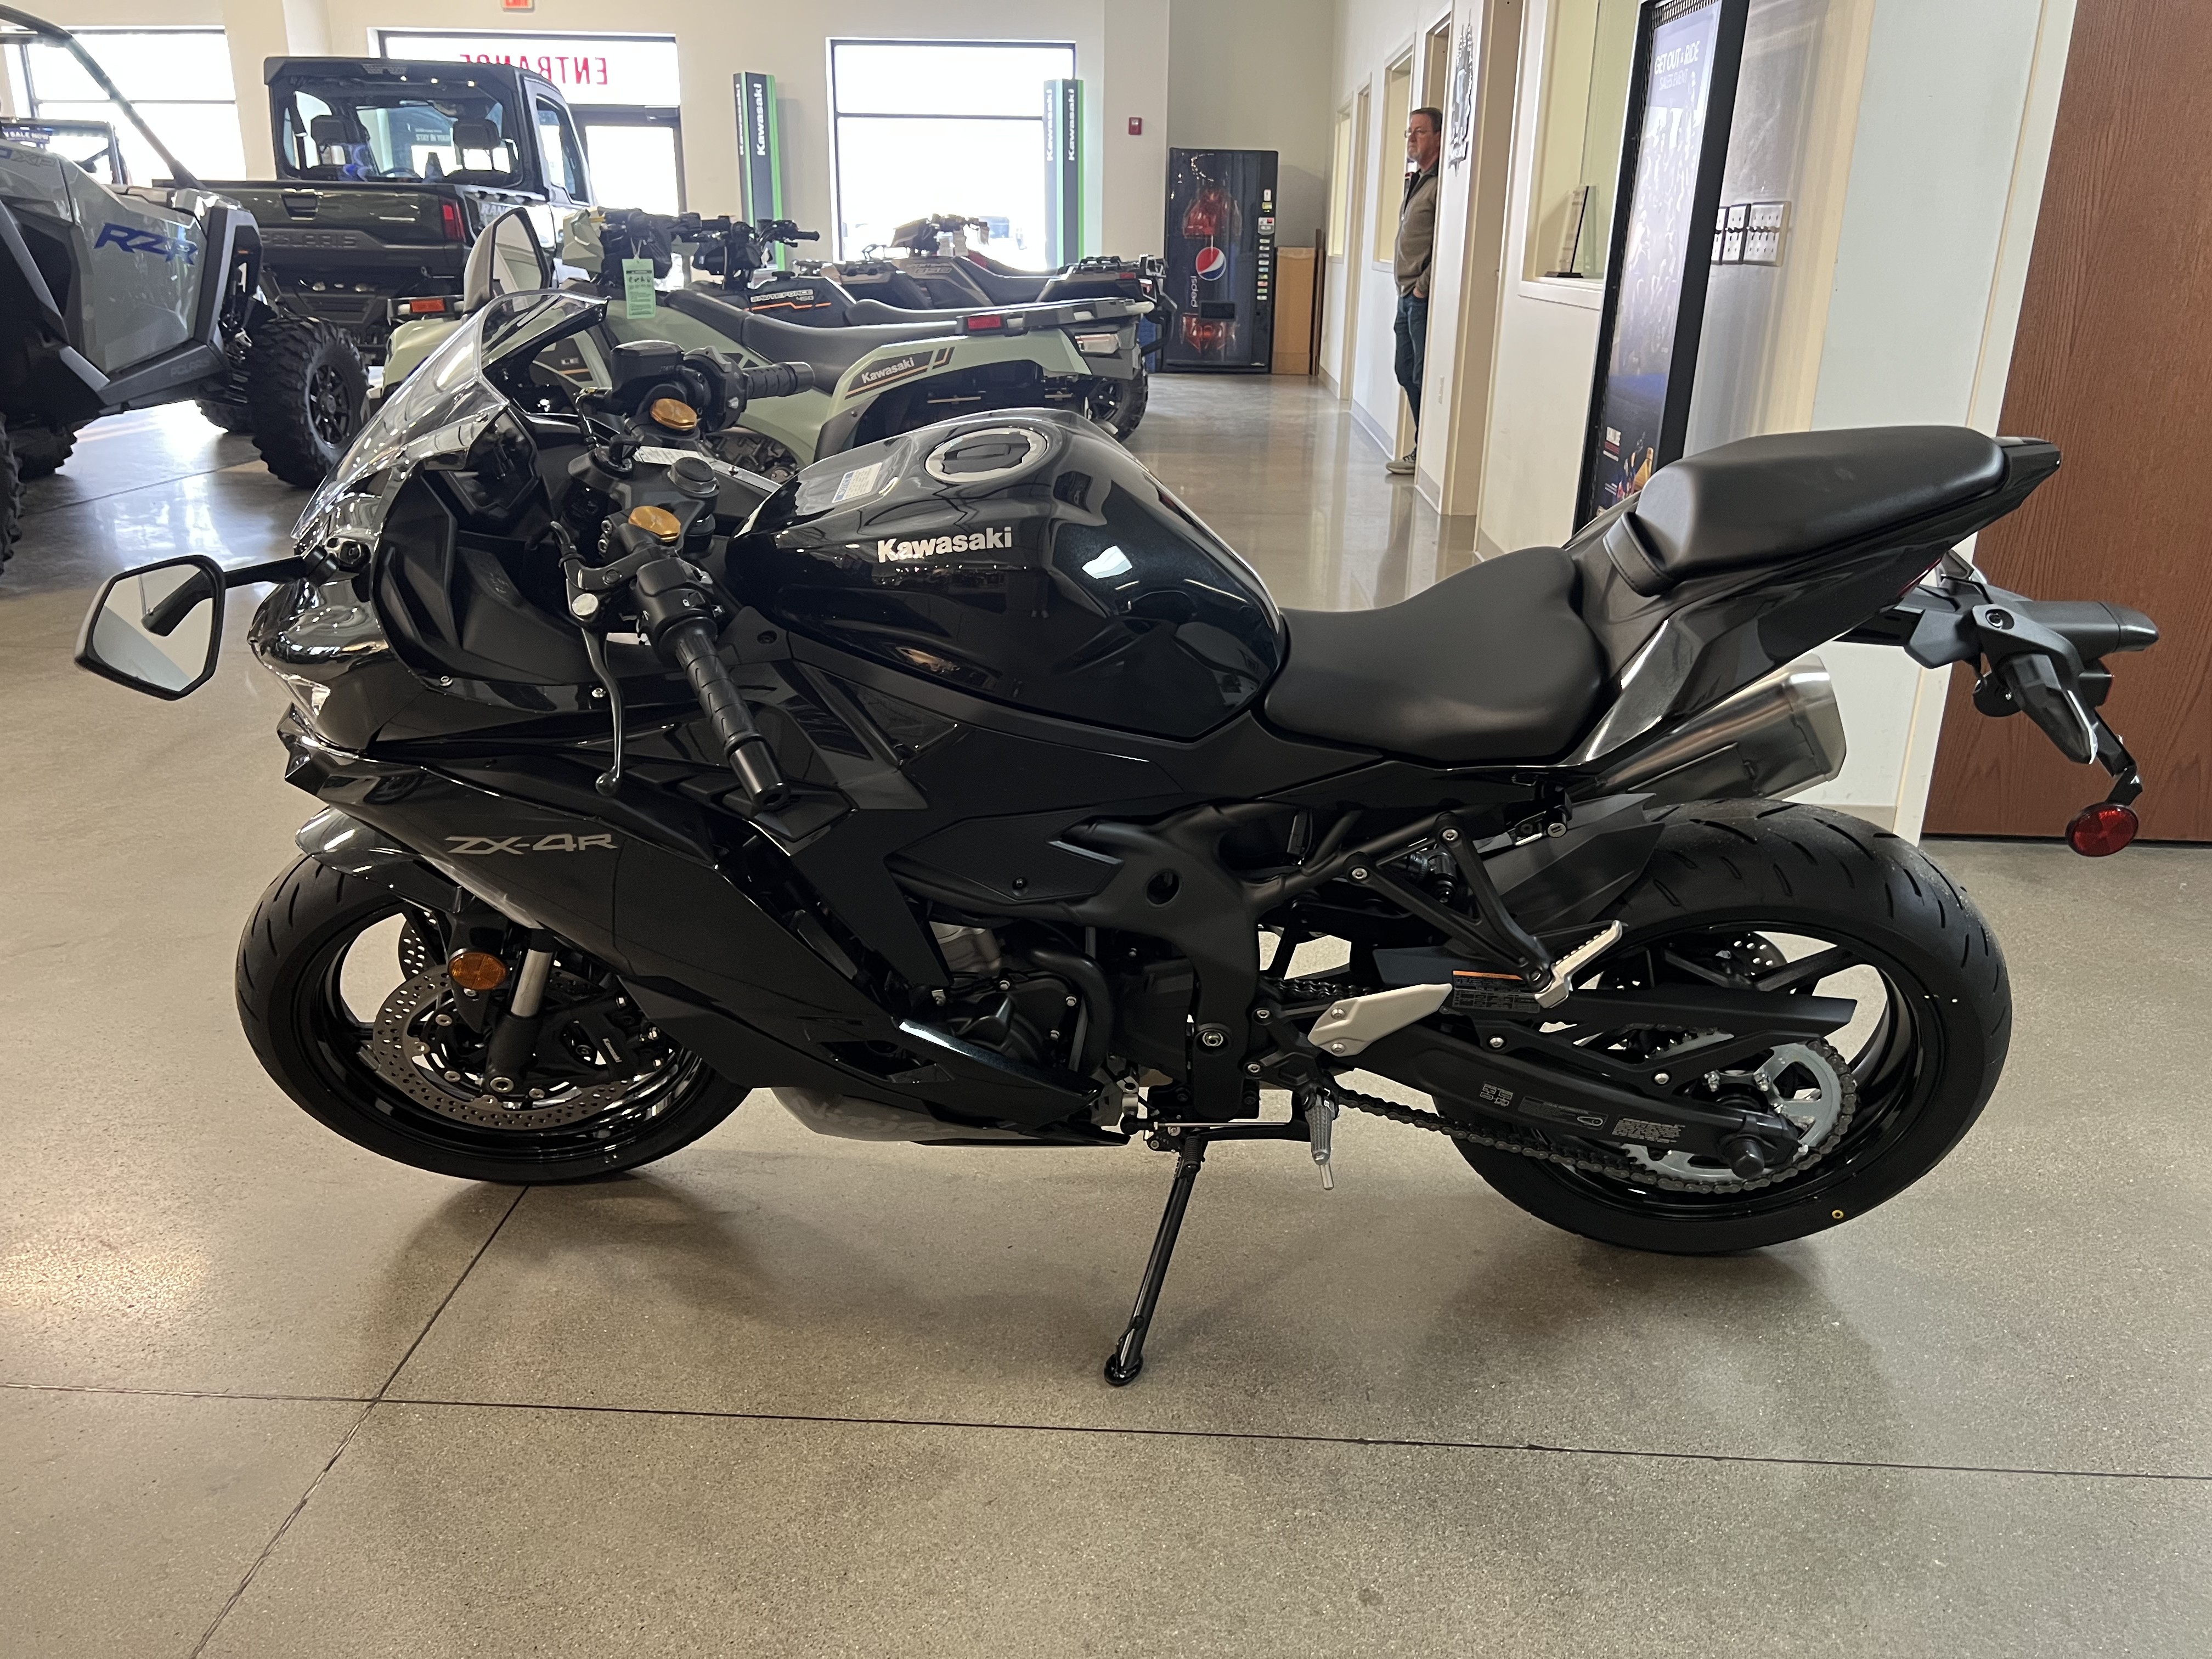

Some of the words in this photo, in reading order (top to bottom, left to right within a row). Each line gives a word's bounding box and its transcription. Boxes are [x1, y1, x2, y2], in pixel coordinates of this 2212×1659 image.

[1655, 53, 1667, 75] GET
[1667, 48, 1681, 71] OUT
[1684, 40, 1700, 65] RIDE
[753, 83, 766, 156] Kawasaki
[93, 222, 199, 266] RZR
[1190, 275, 1198, 307] pepsi
[861, 357, 915, 383] Kawasaki
[878, 527, 1012, 563] Kawasaki
[444, 833, 618, 855] ZX-4R
